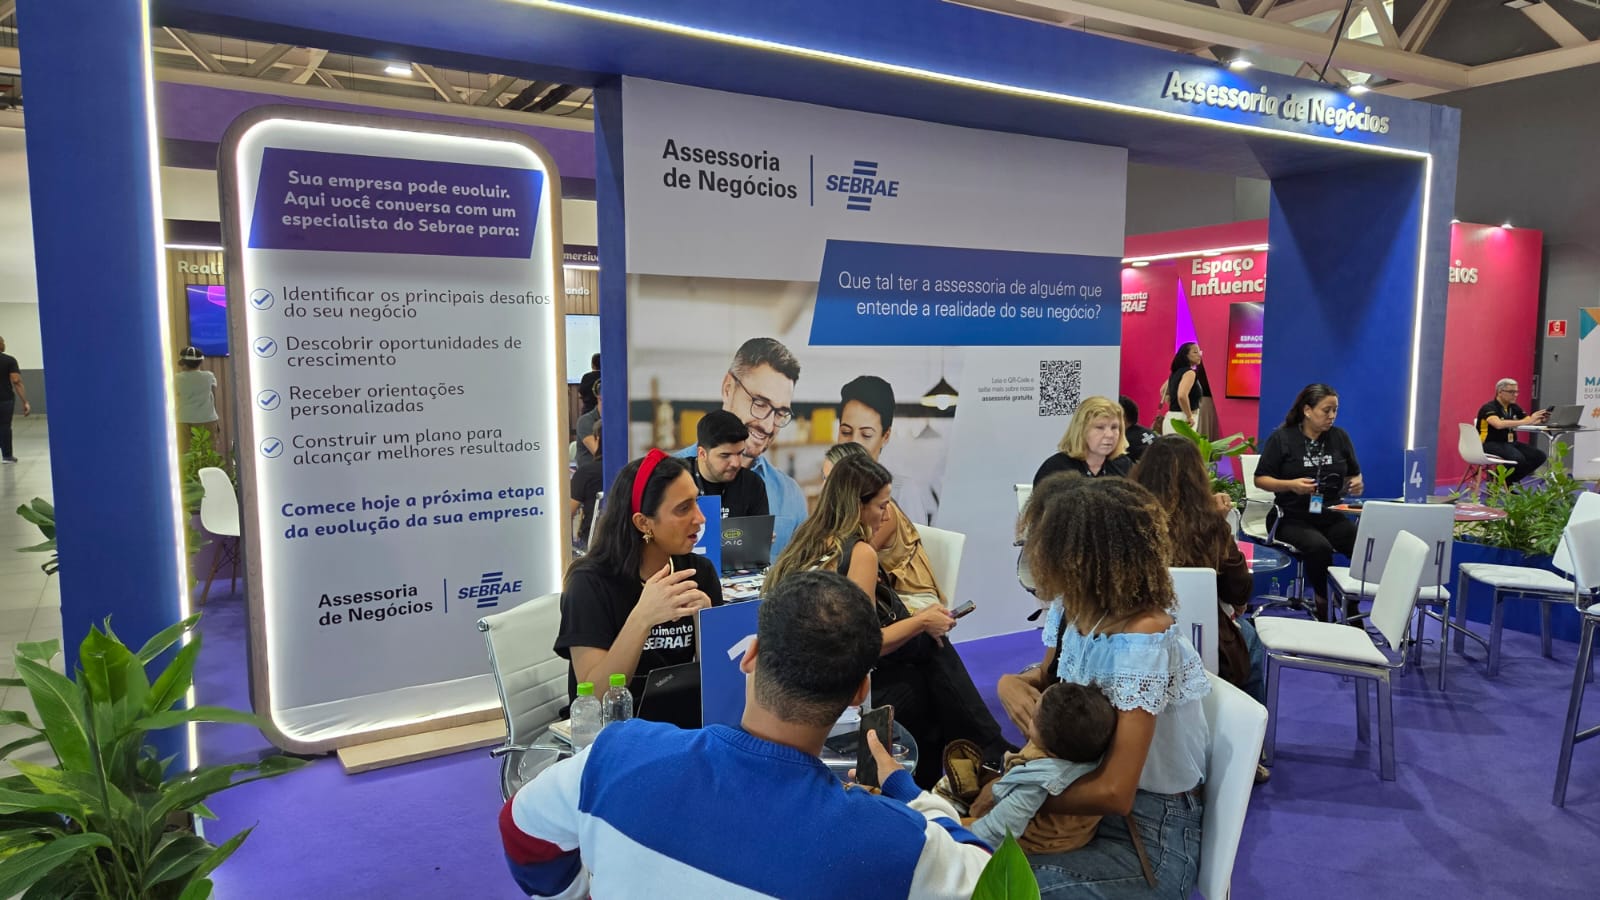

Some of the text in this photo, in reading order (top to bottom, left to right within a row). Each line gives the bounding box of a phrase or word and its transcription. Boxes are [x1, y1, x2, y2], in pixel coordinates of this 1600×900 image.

[1165, 70, 1390, 134] Assessoria de Negócios
[662, 138, 780, 172] Assessoria
[288, 170, 510, 199] Sua empresa pode evoluir.
[663, 167, 798, 199] de Negócios
[825, 174, 900, 198] SEBRAE
[283, 191, 516, 218] Aqui você conversa com um
[281, 213, 520, 238] especialista do Sebrae para:
[1191, 257, 1254, 278] Espaço
[283, 286, 551, 307] Identificar os principais desafios
[838, 270, 1102, 300] Que tal ter a assessoria de alguém que
[284, 303, 417, 322] do seu negócio
[856, 299, 1101, 322] entende a realidade do seu negócio?
[286, 335, 522, 353] Descobrir oportunidades de
[287, 352, 396, 367] crescimento
[289, 382, 465, 400] Receber orientações
[290, 398, 424, 421] personalizadas
[292, 428, 502, 449] Construir um plano para
[293, 438, 541, 466] alcançar melhores resultados
[1409, 461, 1423, 488] 4
[281, 486, 545, 517] Comece hoje a próxima etapa
[284, 506, 544, 539] da evolução da sua empresa.
[318, 583, 418, 609] Assessoria
[457, 580, 523, 600] SEBRAE
[318, 599, 433, 626] de Negócios
[649, 624, 694, 636] vimento
